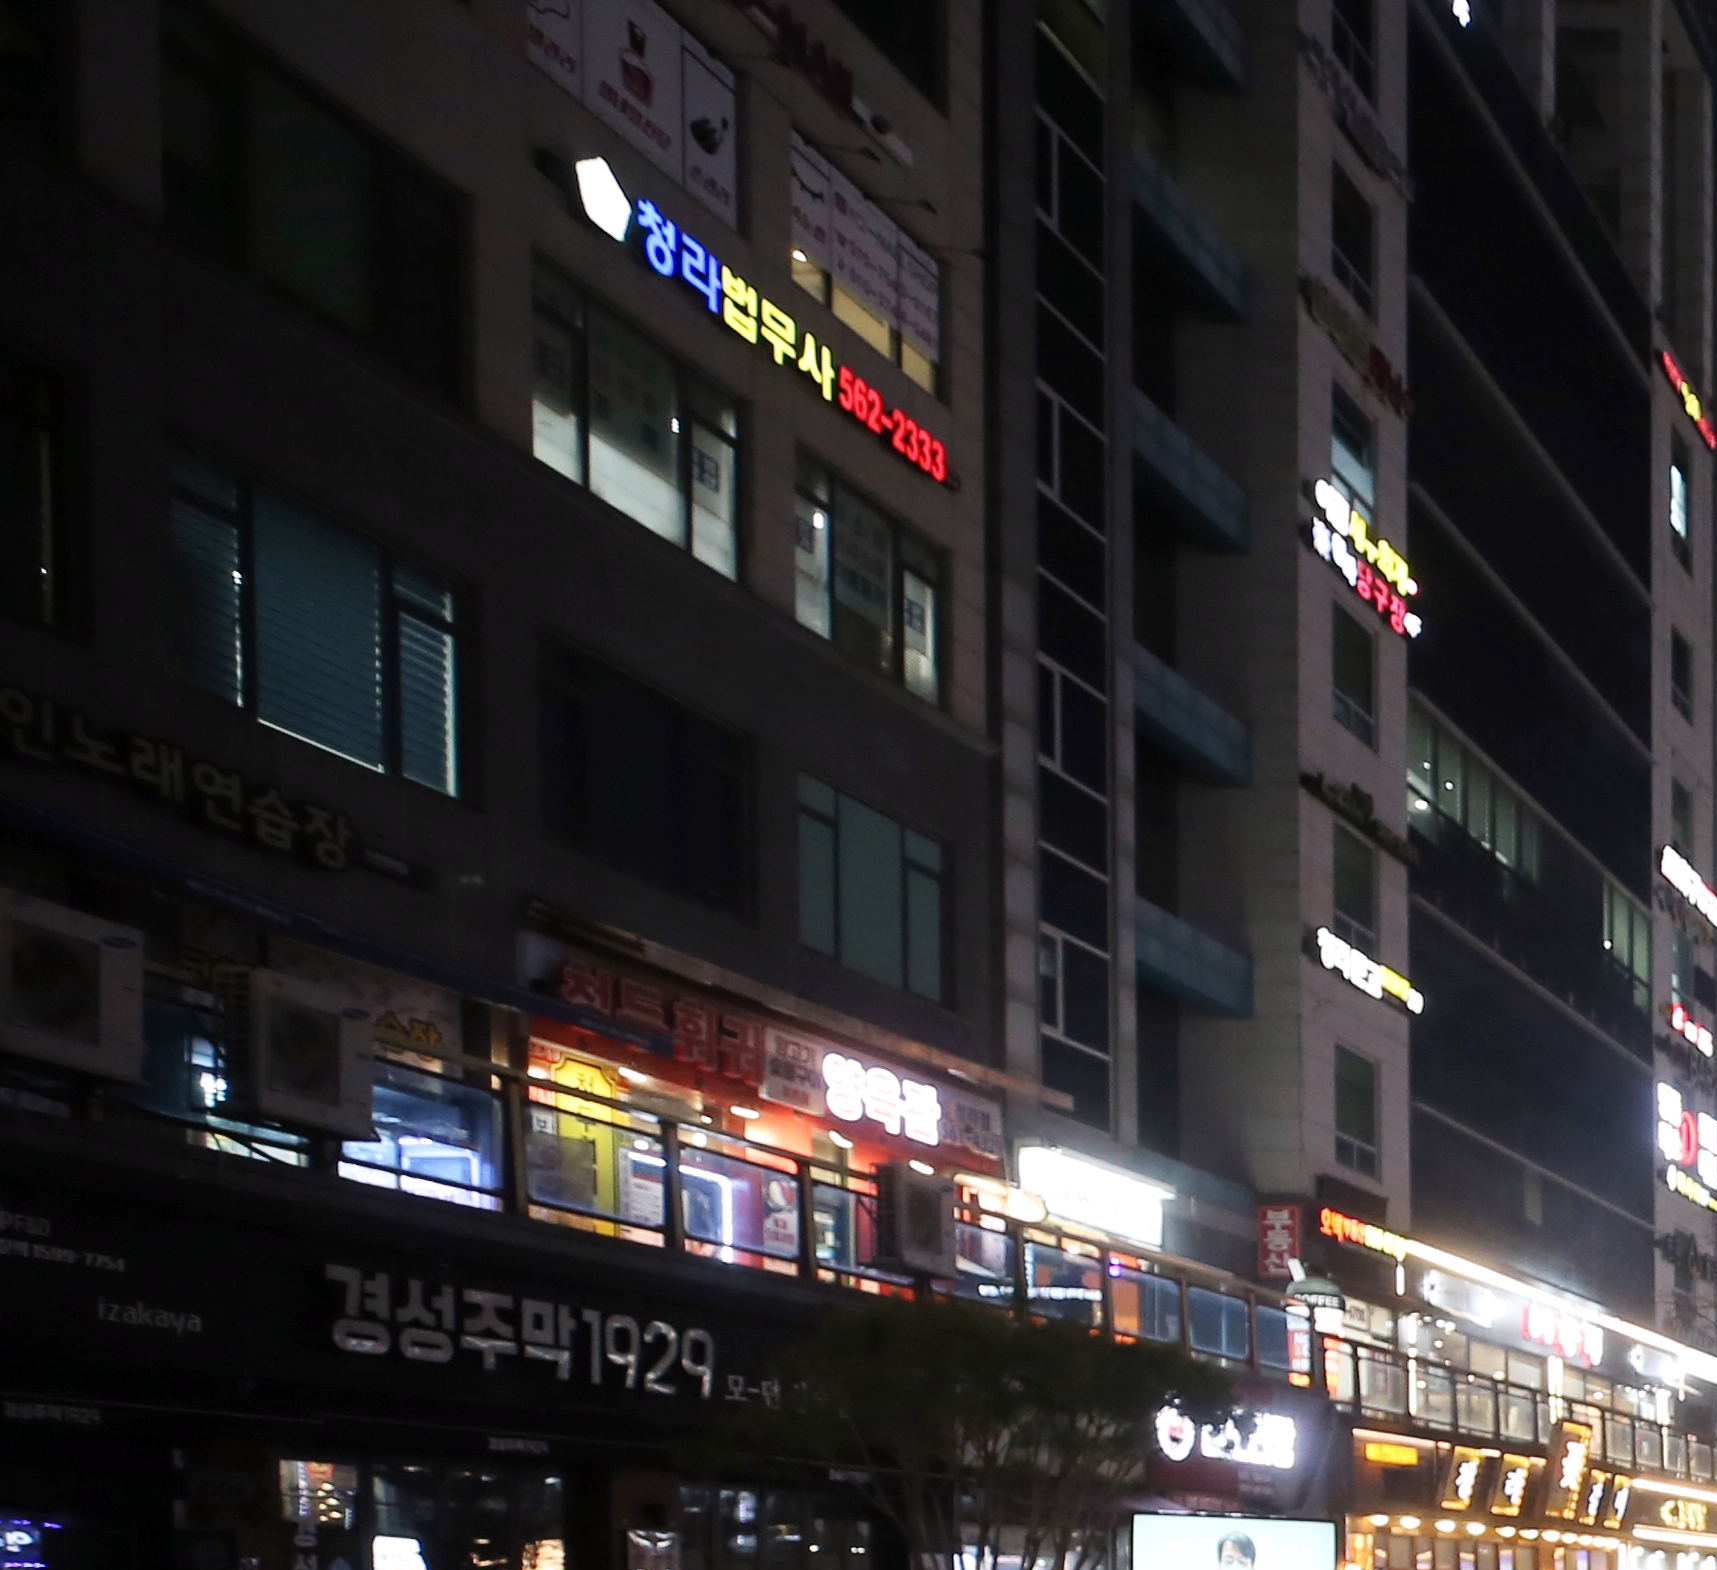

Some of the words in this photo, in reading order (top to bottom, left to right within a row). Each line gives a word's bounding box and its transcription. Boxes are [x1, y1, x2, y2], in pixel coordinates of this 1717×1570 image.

[636, 197, 836, 403] 청라법무사
[837, 365, 948, 483] 562-2333
[1263, 1208, 1294, 1274] 부동산
[96, 1297, 204, 1334] izakaya
[324, 1263, 716, 1400] 경성주막1929
